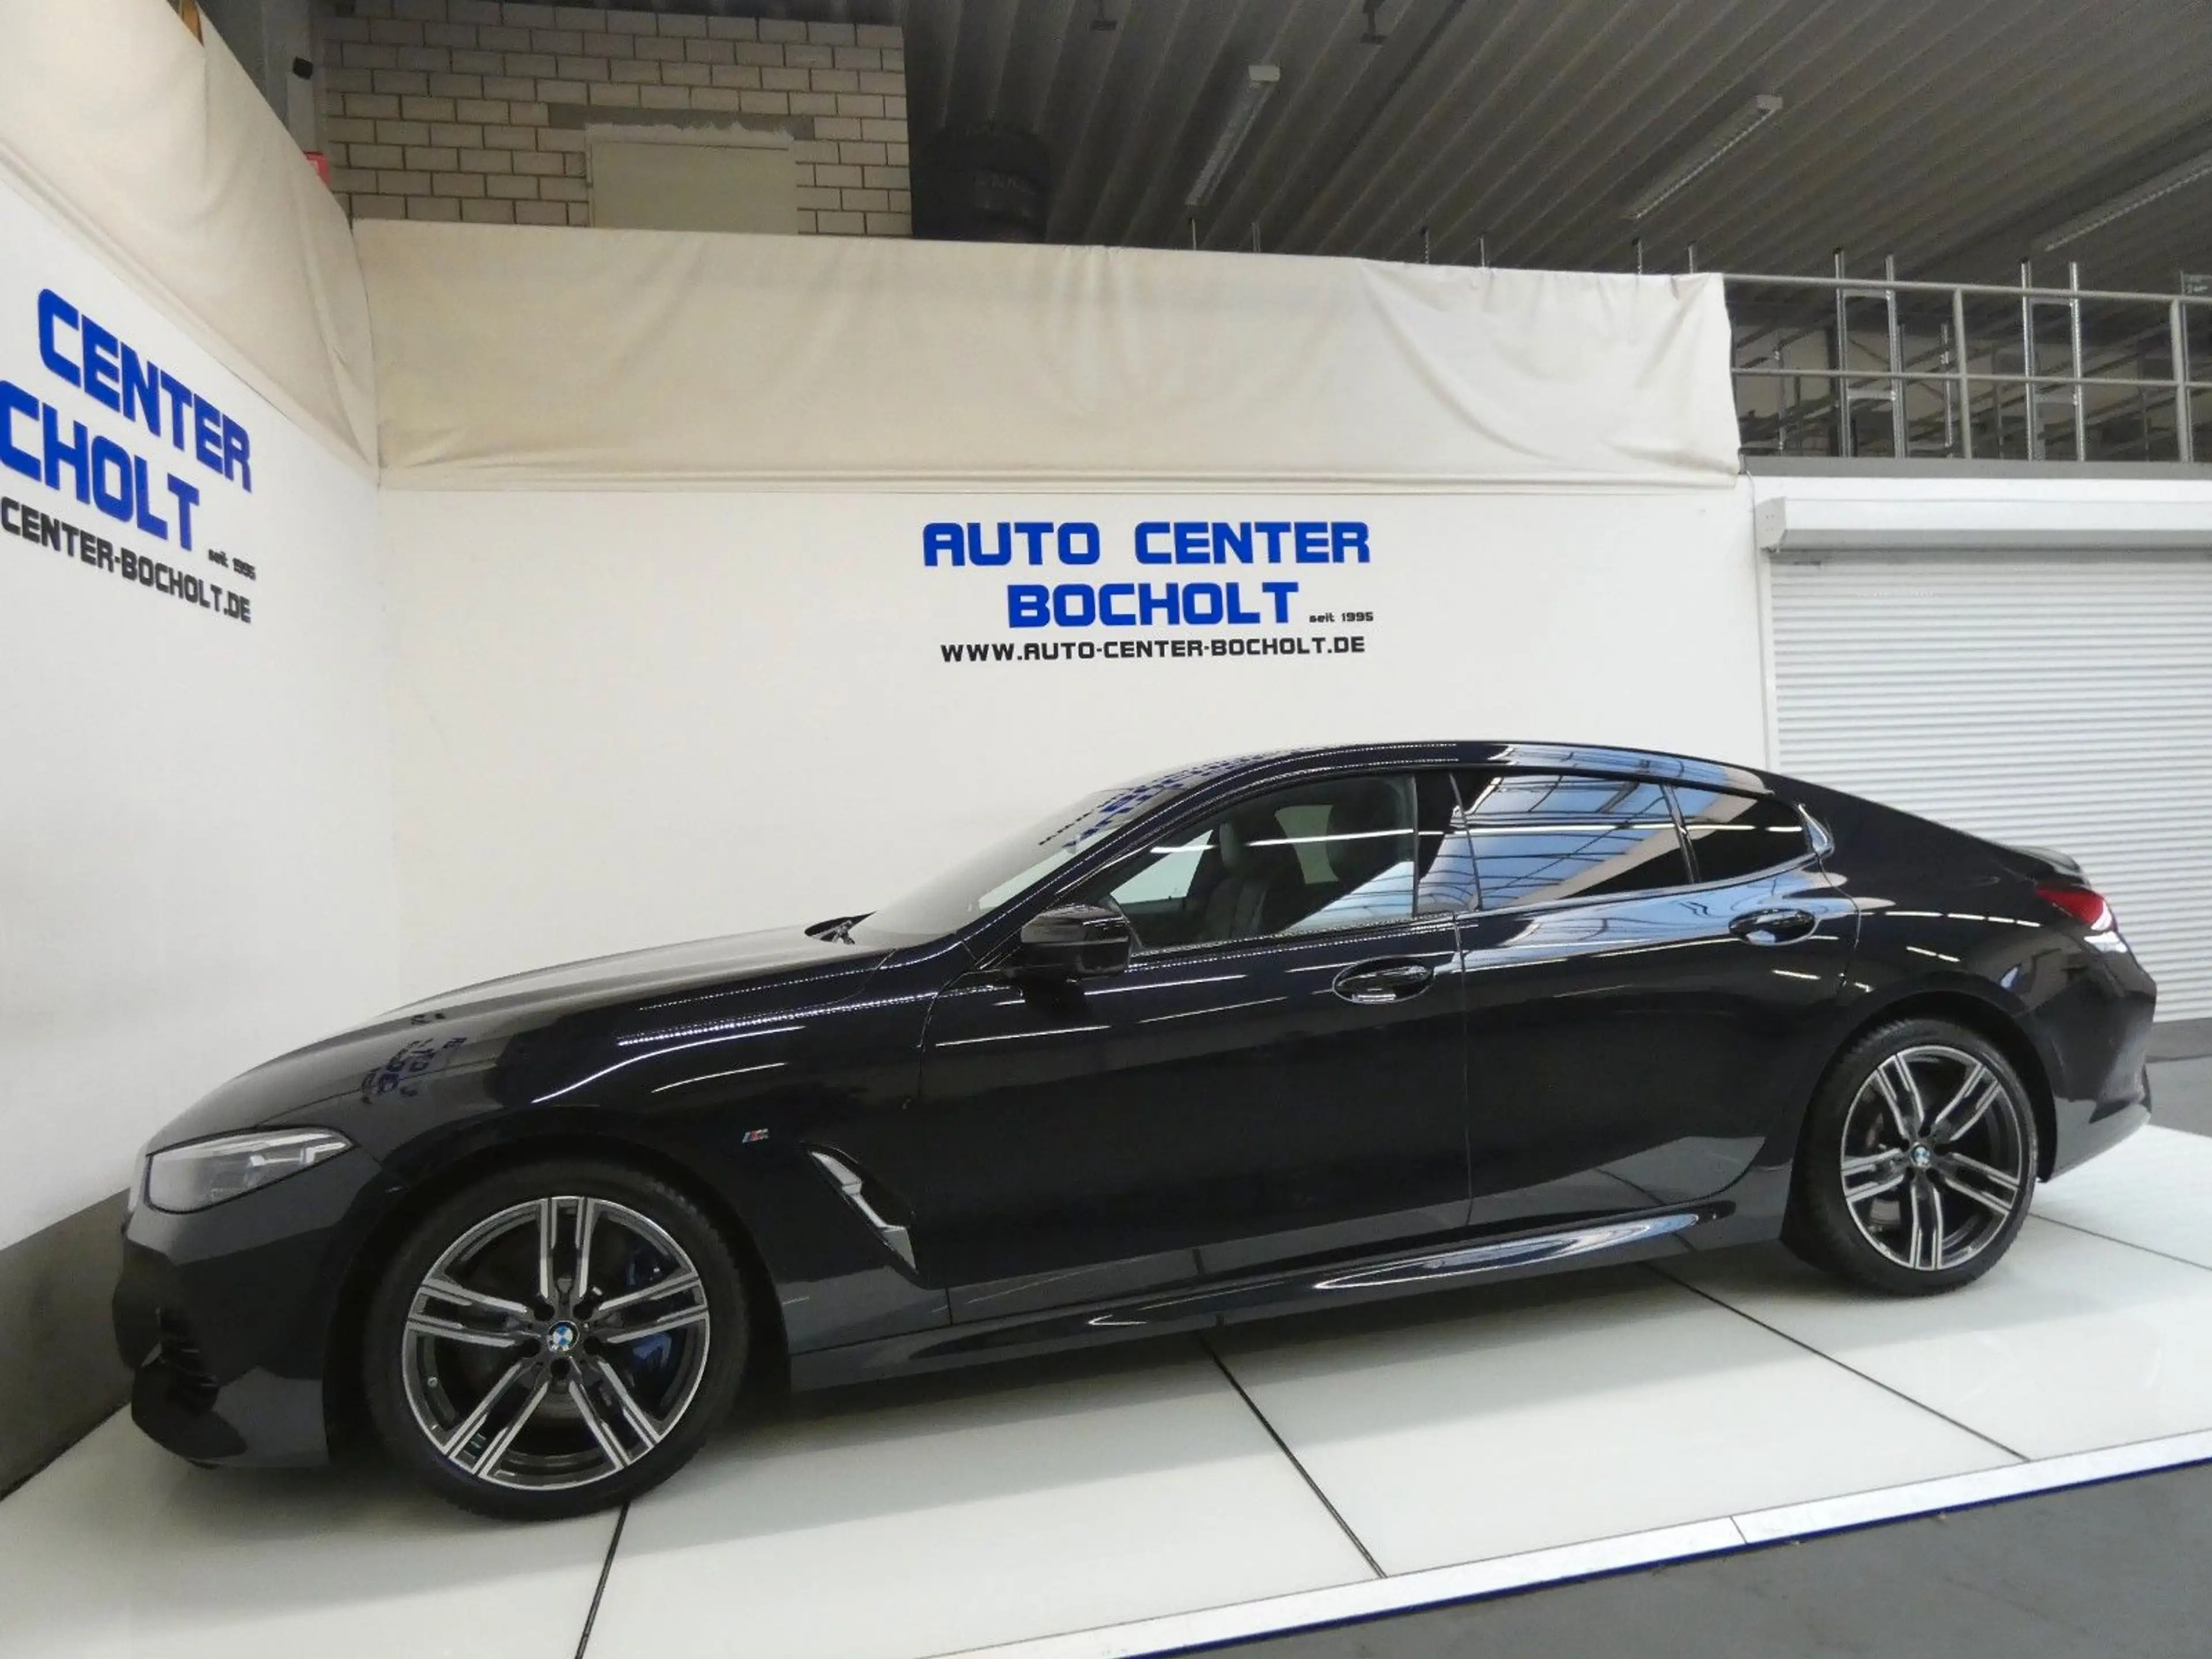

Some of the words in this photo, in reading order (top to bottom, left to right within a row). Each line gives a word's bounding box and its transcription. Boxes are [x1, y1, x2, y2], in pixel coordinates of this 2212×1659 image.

[37, 288, 252, 493] CENTER
[1, 496, 251, 624] CENTER-BOCHOLT.DE
[922, 521, 1101, 567] AUTO
[1134, 521, 1371, 566] CENTER
[1007, 581, 1300, 629] BOCHOLT
[1309, 612, 1335, 623] seit
[1341, 611, 1374, 622] 1995
[941, 636, 1365, 662] WWW.AUTO-CENTER-BOCHOLT.DE
